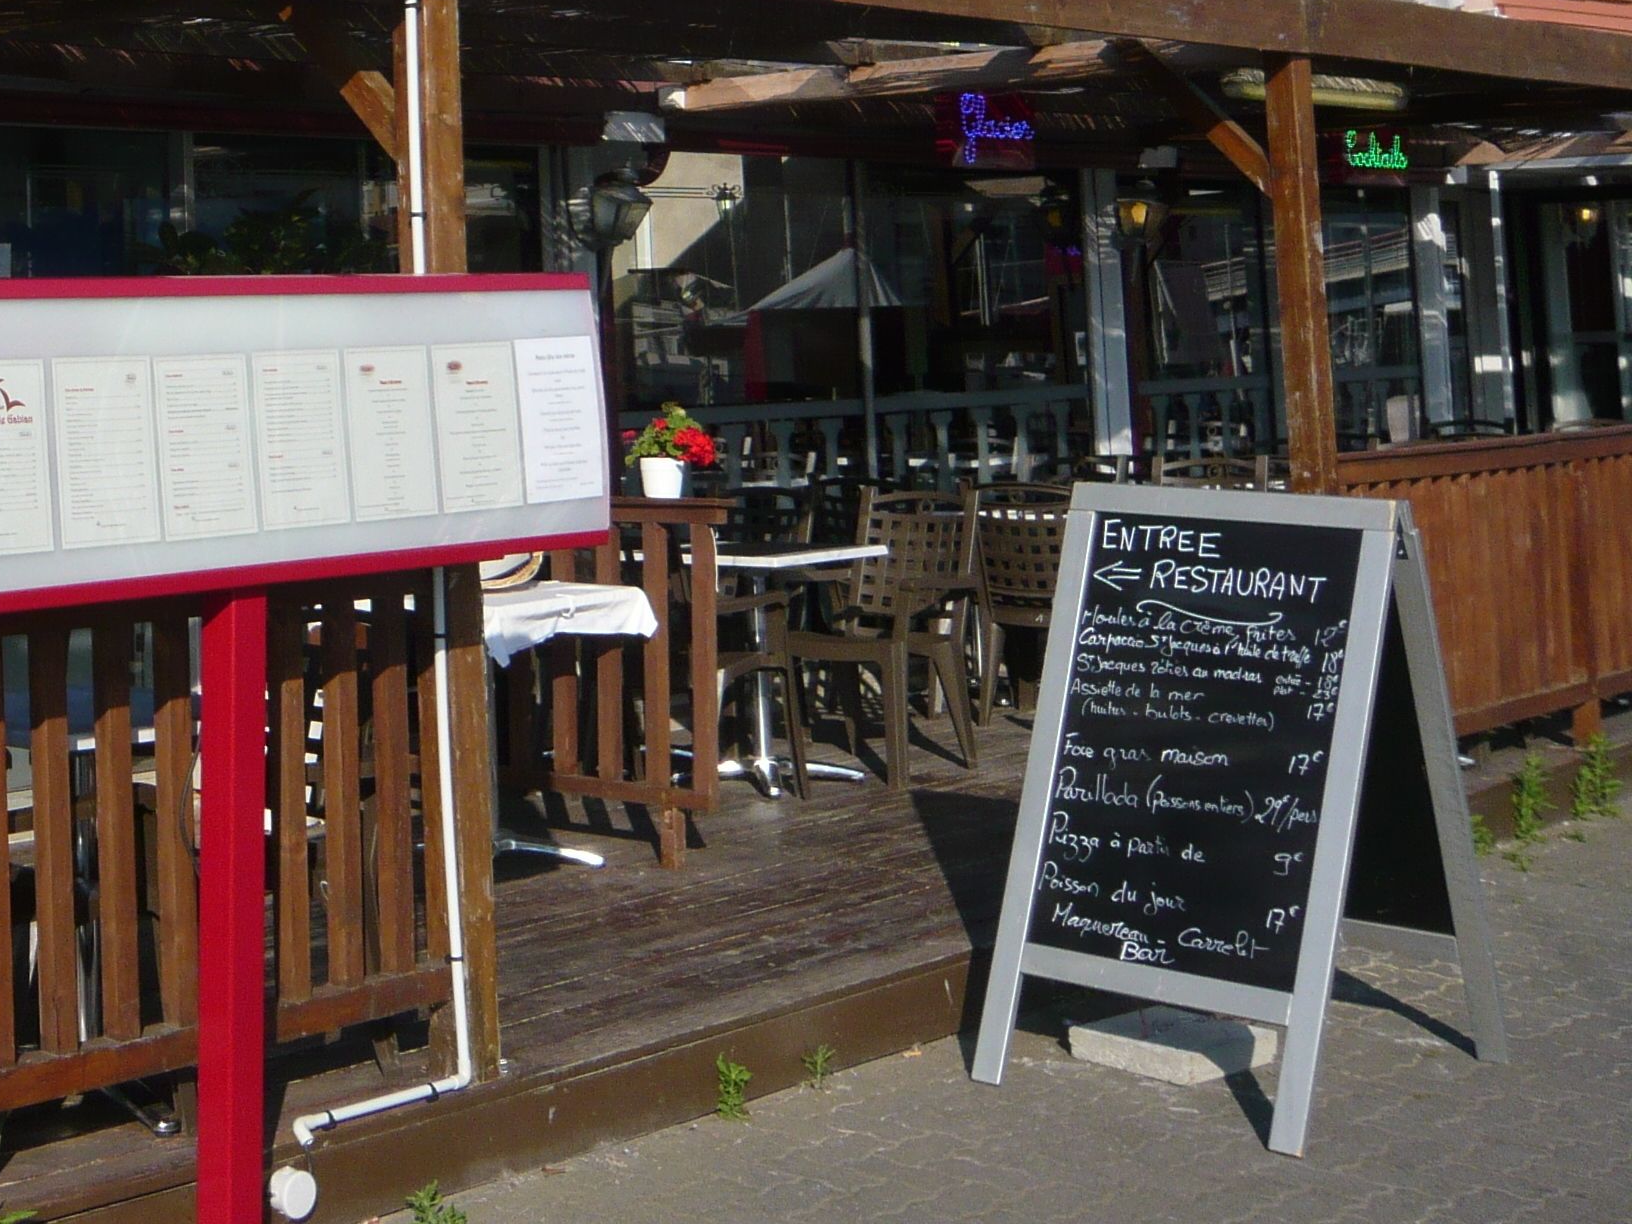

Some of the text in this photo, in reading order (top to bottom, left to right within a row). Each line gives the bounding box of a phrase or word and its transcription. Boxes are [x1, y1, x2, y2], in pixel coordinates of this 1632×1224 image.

[1103, 519, 1221, 558] ENTREE
[1149, 559, 1328, 604] RESTAURANT
[1070, 678, 1122, 697] Assiette
[1125, 683, 1141, 697] de
[1168, 691, 1206, 701] mer
[1288, 750, 1324, 775] 17€
[1048, 811, 1100, 863] Pizza
[1110, 832, 1121, 848] à
[1181, 843, 1206, 862] de
[1038, 861, 1099, 897] Poisson
[1111, 881, 1137, 903] du
[1144, 882, 1186, 916] jour
[1120, 940, 1176, 964] Bar
